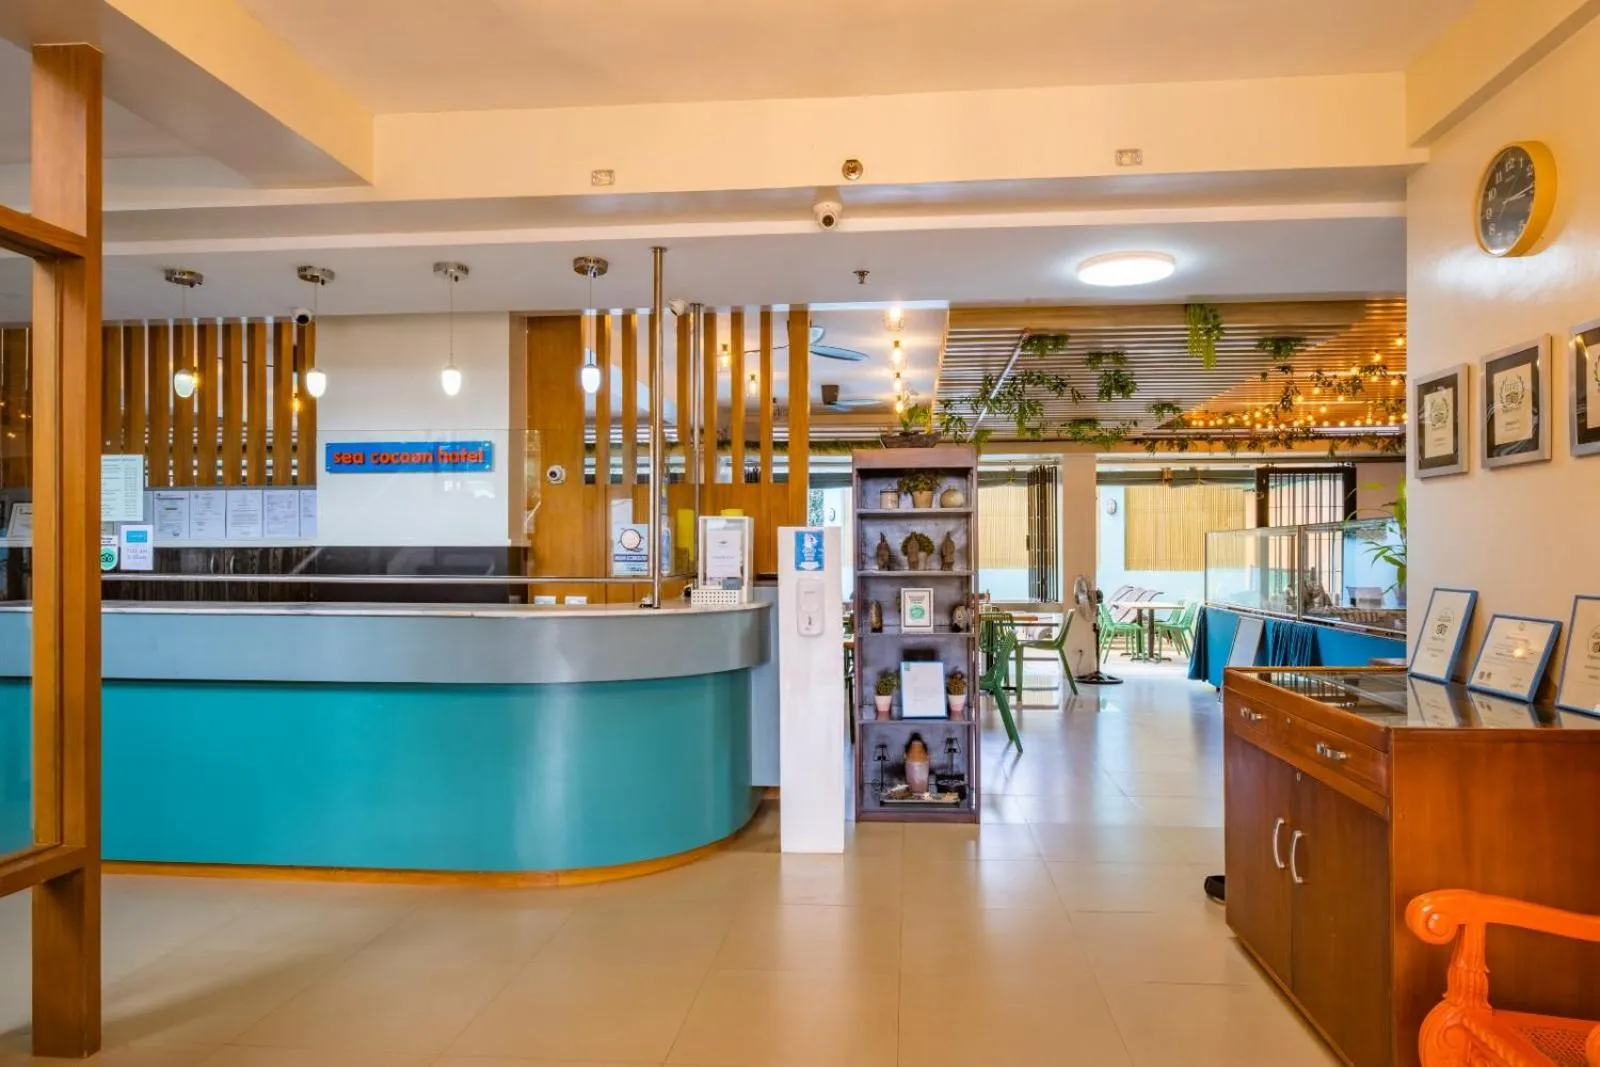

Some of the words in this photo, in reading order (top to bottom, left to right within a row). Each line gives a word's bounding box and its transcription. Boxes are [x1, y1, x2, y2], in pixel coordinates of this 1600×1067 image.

[1487, 188, 1497, 201] 10
[1485, 208, 1493, 219] 9
[1488, 223, 1496, 235] 8
[333, 451, 365, 465] sea
[438, 447, 484, 464] hotel
